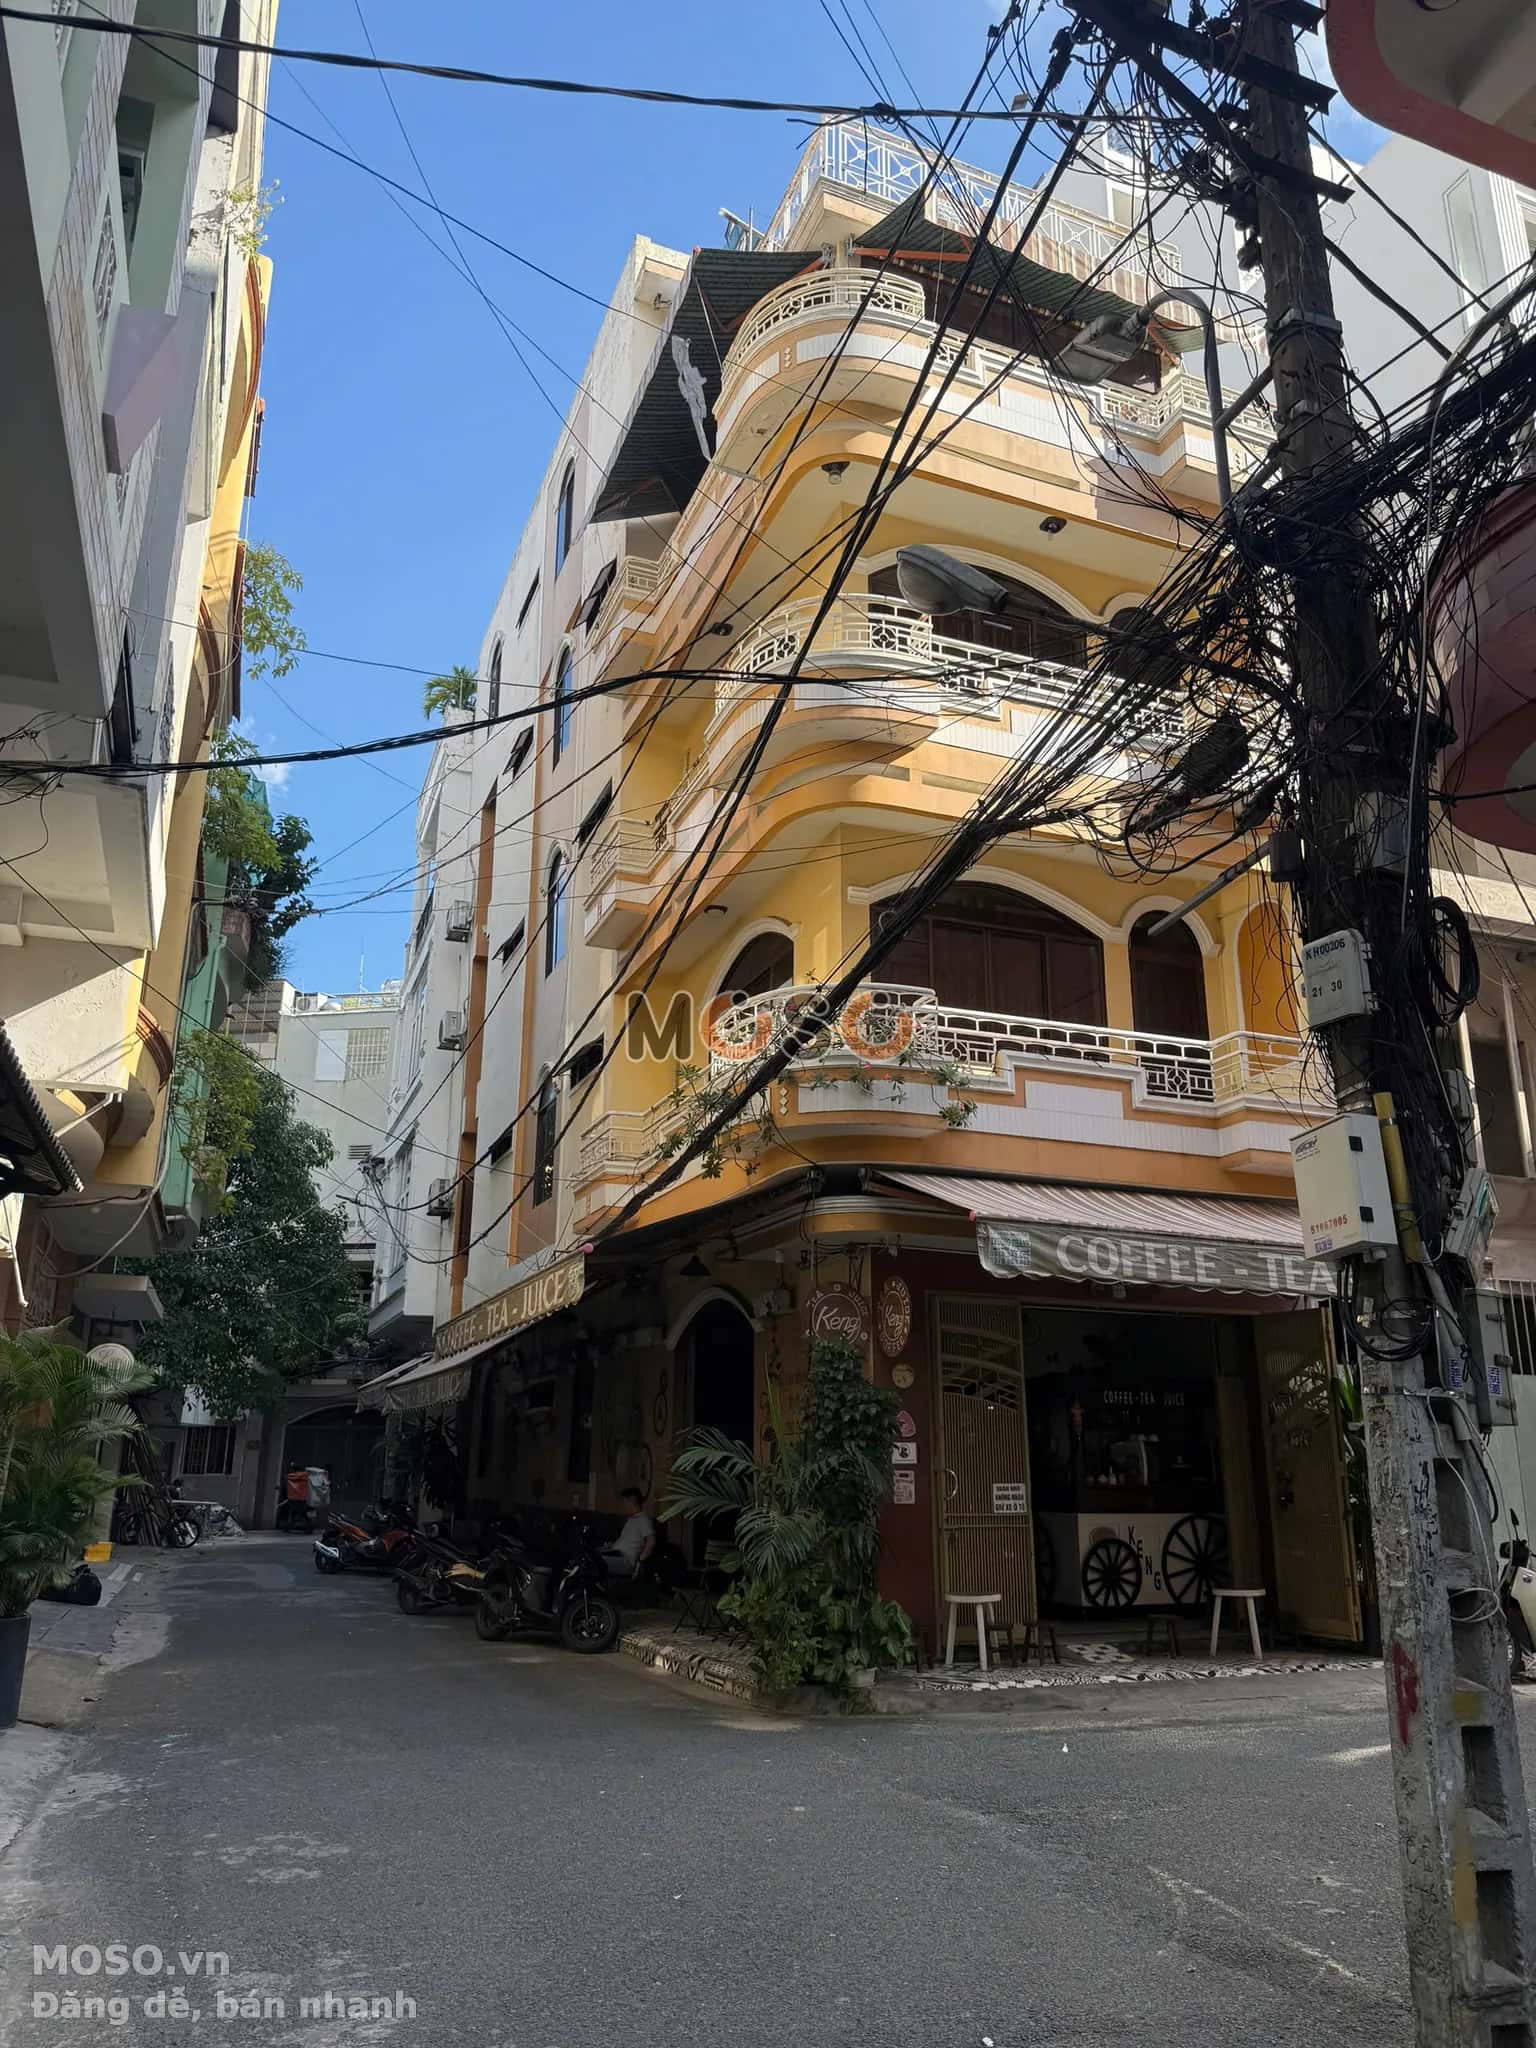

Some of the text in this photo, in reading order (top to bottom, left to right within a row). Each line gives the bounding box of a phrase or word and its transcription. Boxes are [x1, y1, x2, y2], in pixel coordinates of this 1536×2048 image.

[1311, 985, 1322, 998] 21
[1056, 1234, 1222, 1284] COFFEE
[1257, 1251, 1338, 1294] TEA
[486, 1298, 508, 1335] TEA
[520, 1268, 567, 1320] JUICE
[815, 1305, 860, 1340] Keng
[1128, 1526, 1161, 1591] KENG
